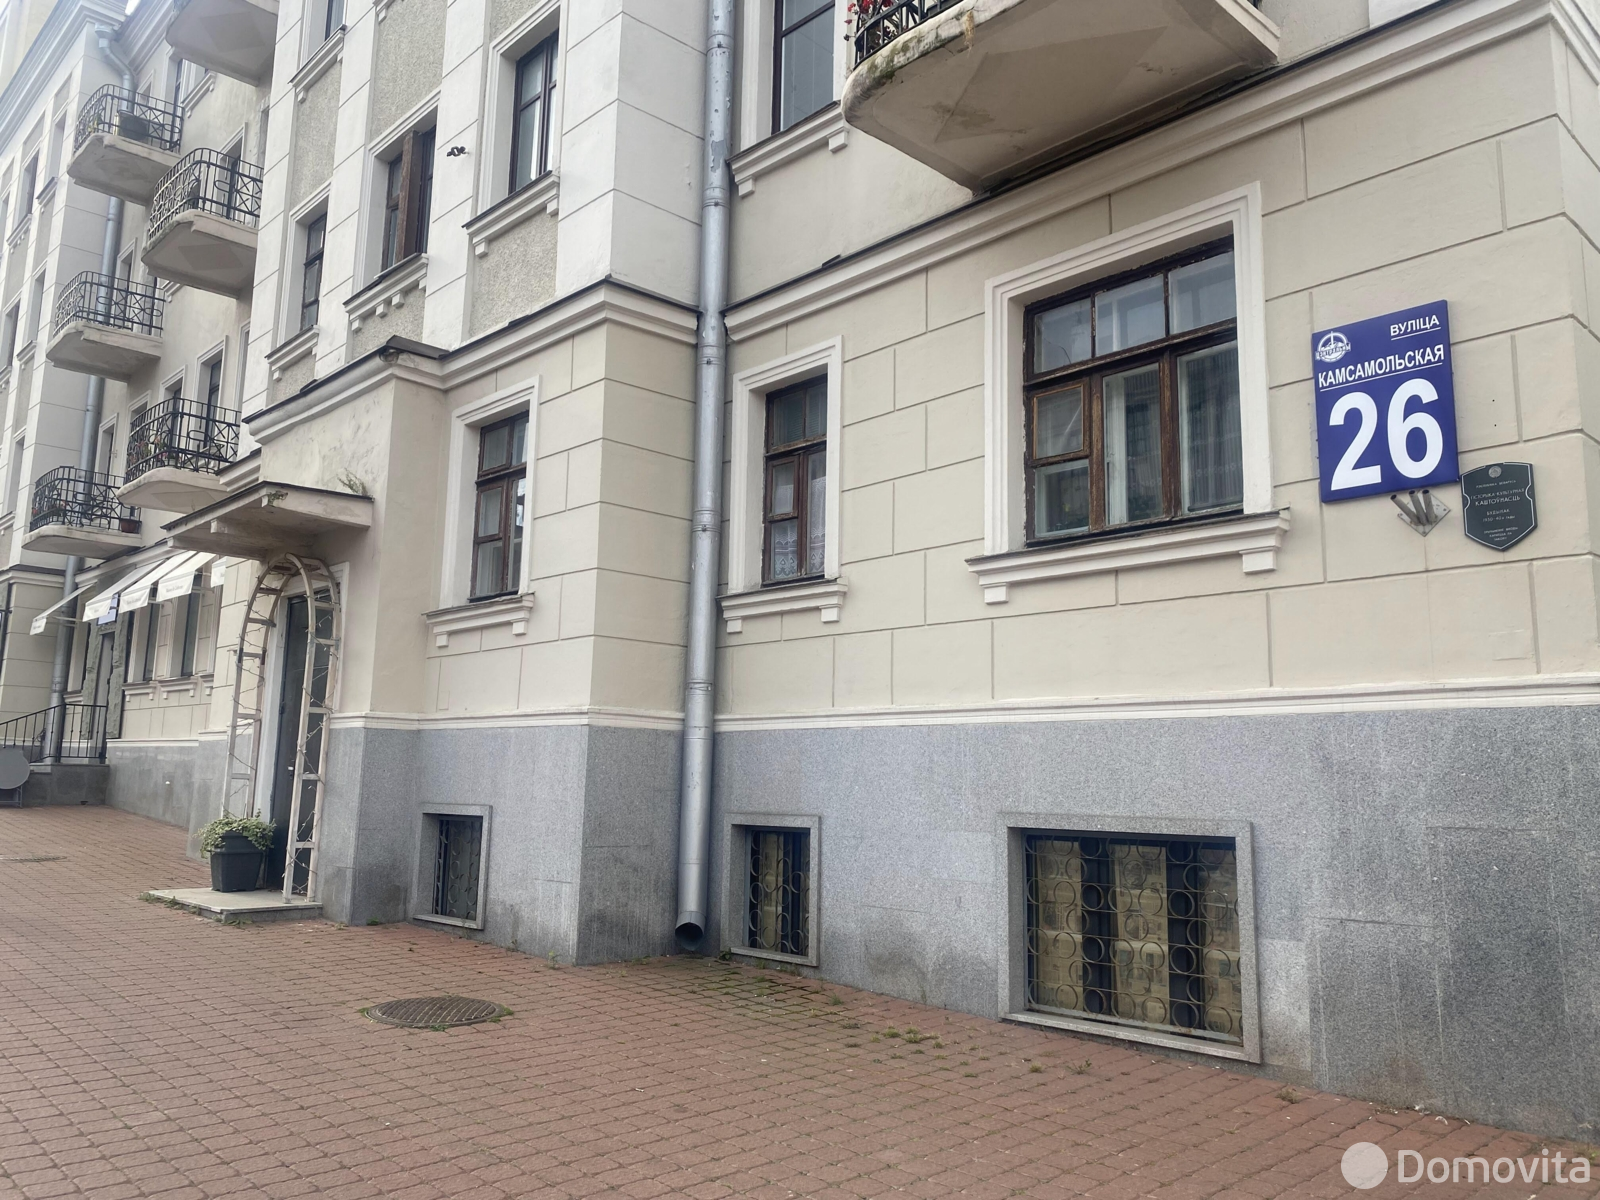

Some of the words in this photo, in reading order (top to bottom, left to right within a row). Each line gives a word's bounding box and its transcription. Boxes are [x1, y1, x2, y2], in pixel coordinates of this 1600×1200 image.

[1390, 315, 1440, 336] ВУЛІЦА
[1318, 344, 1445, 388] КАМСАМОЛЬСКАЯ
[1329, 378, 1444, 491] 26
